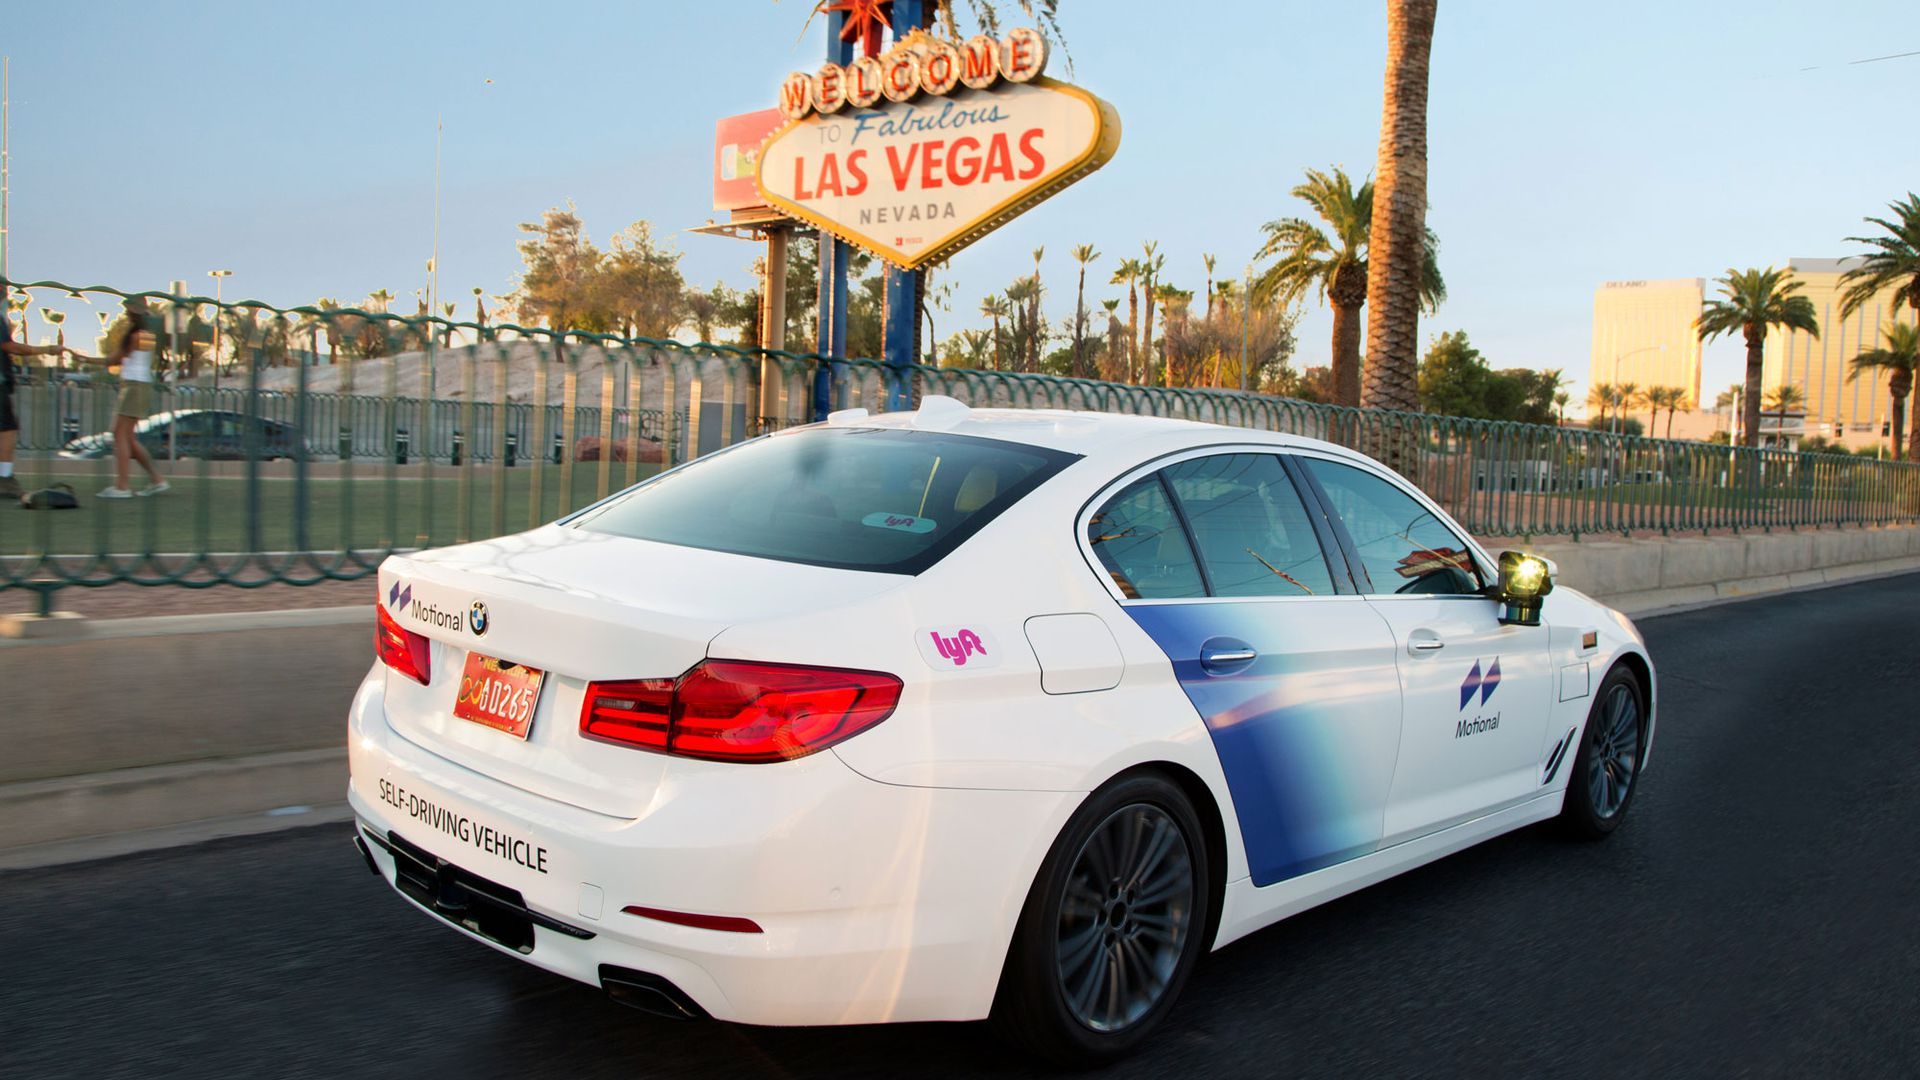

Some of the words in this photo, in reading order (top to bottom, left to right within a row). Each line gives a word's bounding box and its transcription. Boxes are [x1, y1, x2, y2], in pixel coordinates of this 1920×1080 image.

[784, 38, 1032, 112] WELCOME
[817, 124, 841, 145] TO
[850, 101, 1009, 146] Fabulous
[794, 149, 869, 201] LAS
[884, 128, 1046, 192] VEGAS
[860, 201, 956, 225] NEVADA
[884, 515, 915, 528] lyft
[411, 598, 463, 632] Motional
[930, 628, 987, 666] lyft
[1455, 711, 1500, 739] Motional
[379, 778, 469, 842] SELF-DRIVING
[473, 822, 548, 874] VEHICLE
